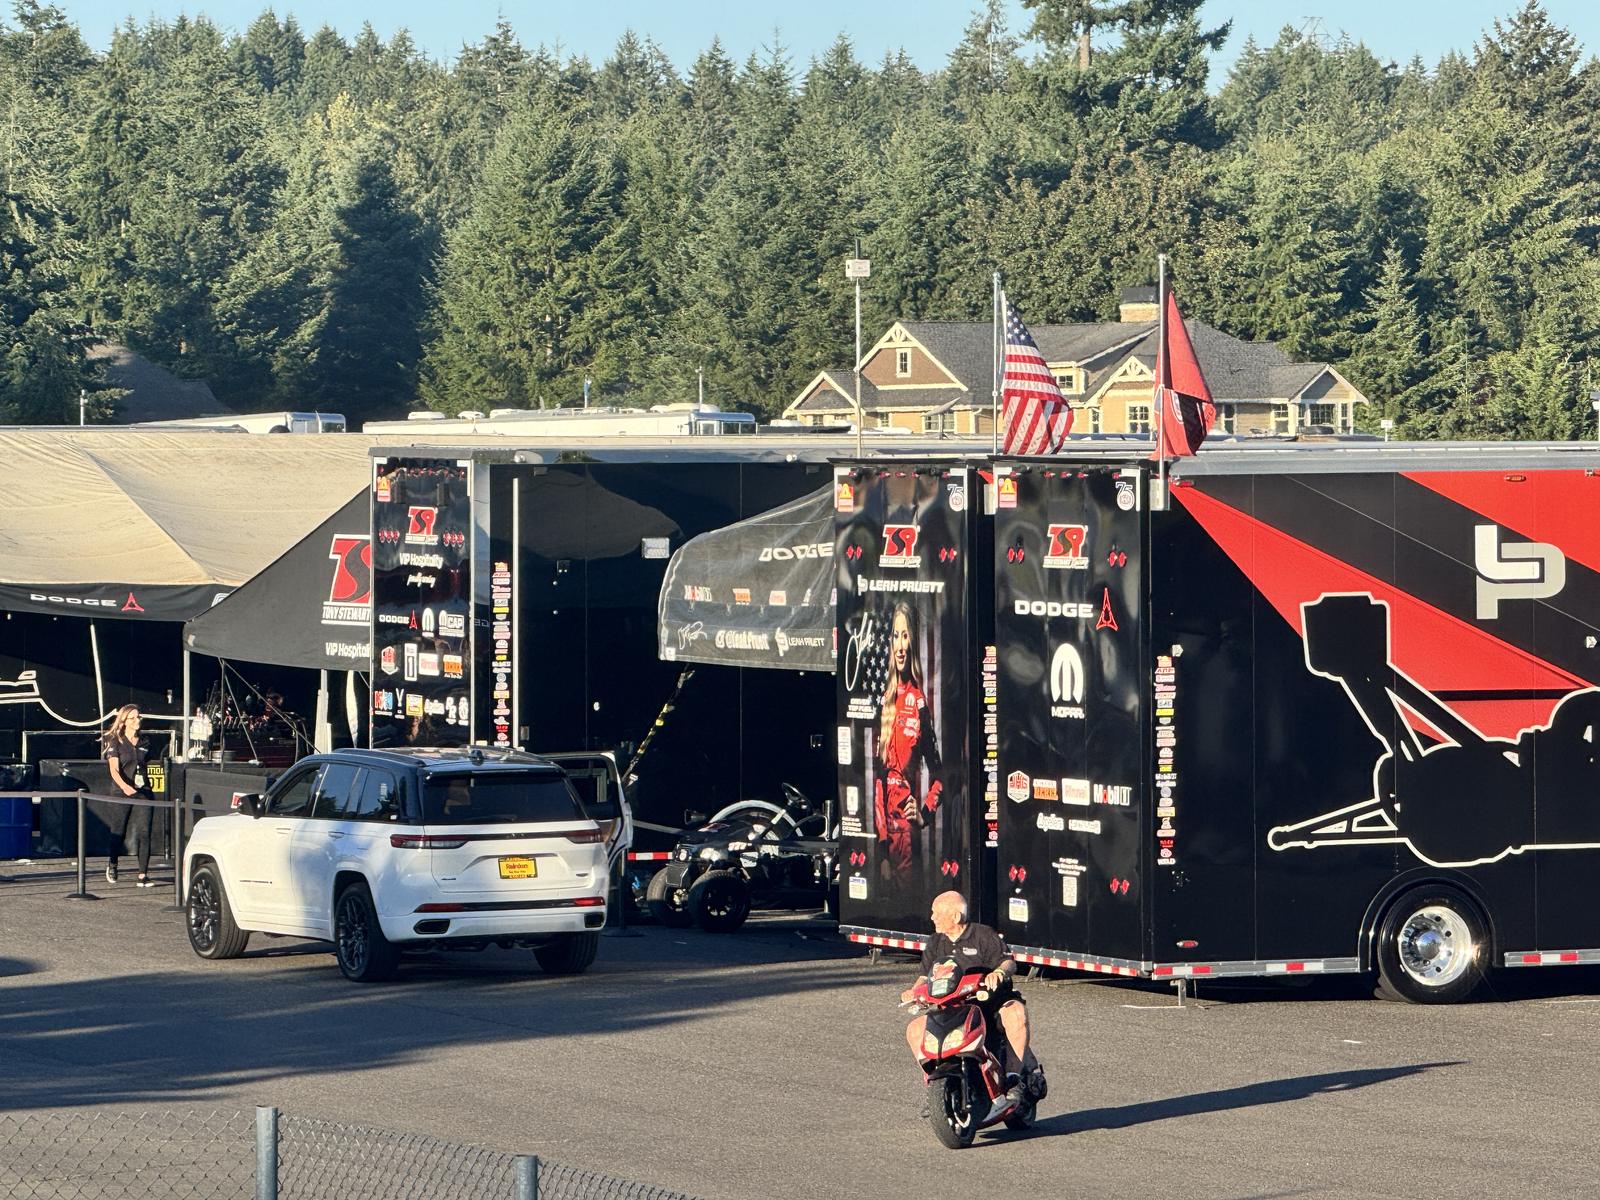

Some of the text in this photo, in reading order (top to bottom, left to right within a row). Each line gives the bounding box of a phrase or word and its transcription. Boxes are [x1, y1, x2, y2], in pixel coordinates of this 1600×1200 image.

[869, 580, 898, 592] LEAH
[30, 593, 117, 607] DODGE
[322, 606, 370, 620] TONY STEWART
[1014, 599, 1094, 618] DODGE
[379, 614, 410, 625] DODGE
[325, 641, 337, 656] VIP
[788, 637, 804, 646] LEAH
